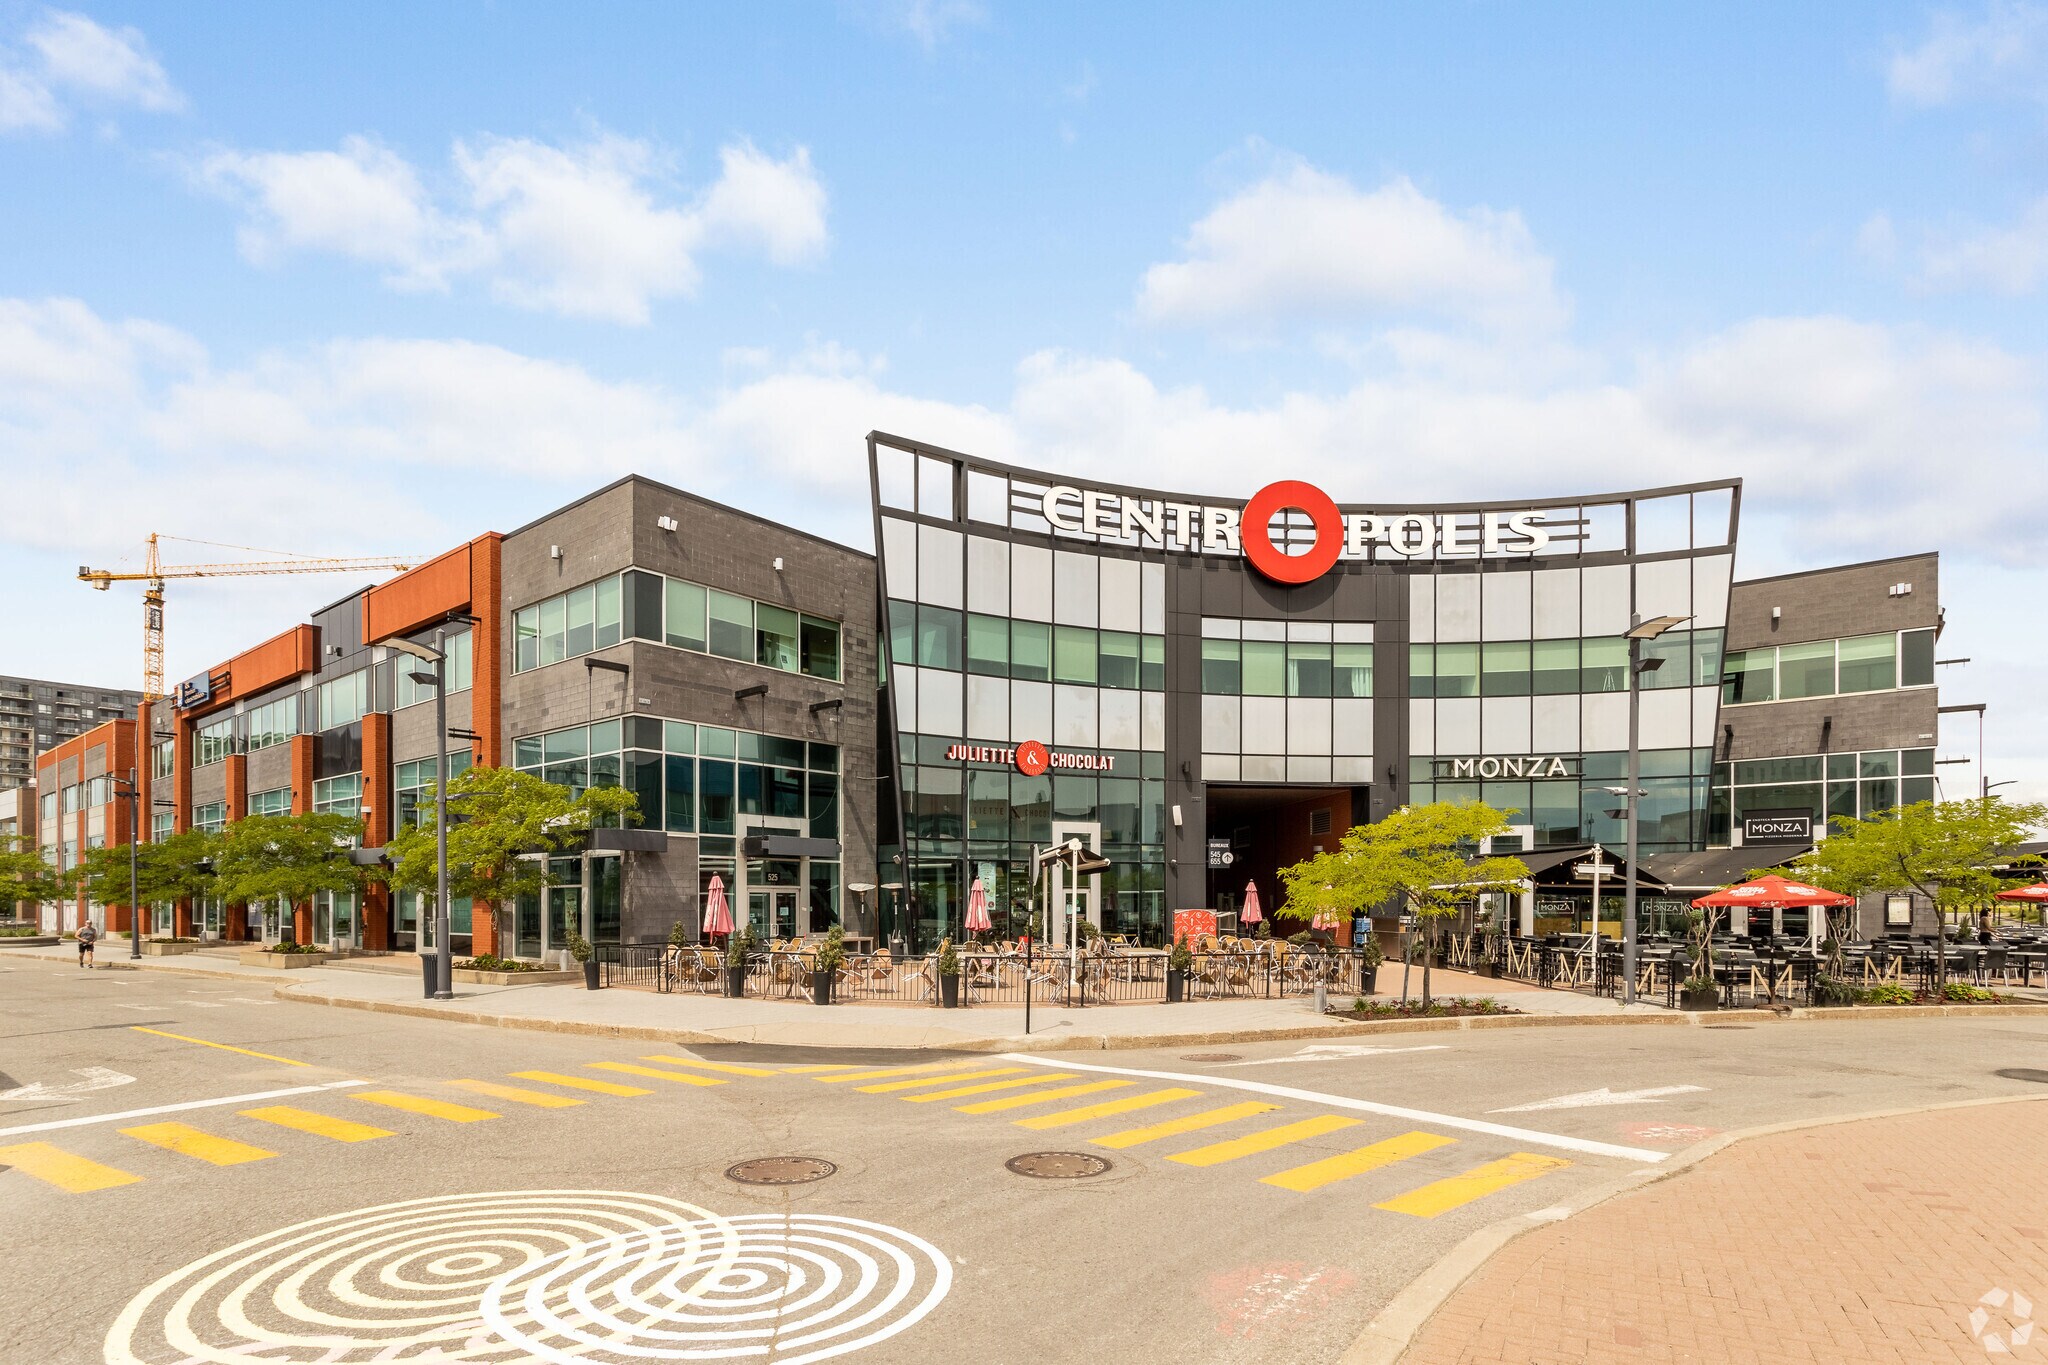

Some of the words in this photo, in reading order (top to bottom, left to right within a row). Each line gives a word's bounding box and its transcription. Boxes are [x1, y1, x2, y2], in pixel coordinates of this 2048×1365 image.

[1043, 480, 1549, 583] CENTROPOLIS
[948, 745, 1015, 764] JULIETTE
[1050, 752, 1115, 770] CHOCOLAT
[1454, 756, 1568, 778] MONZA
[1752, 822, 1803, 833] MONZA
[1540, 903, 1571, 911] MONZA
[1645, 904, 1678, 912] MONZA
[1507, 939, 1531, 977] M
